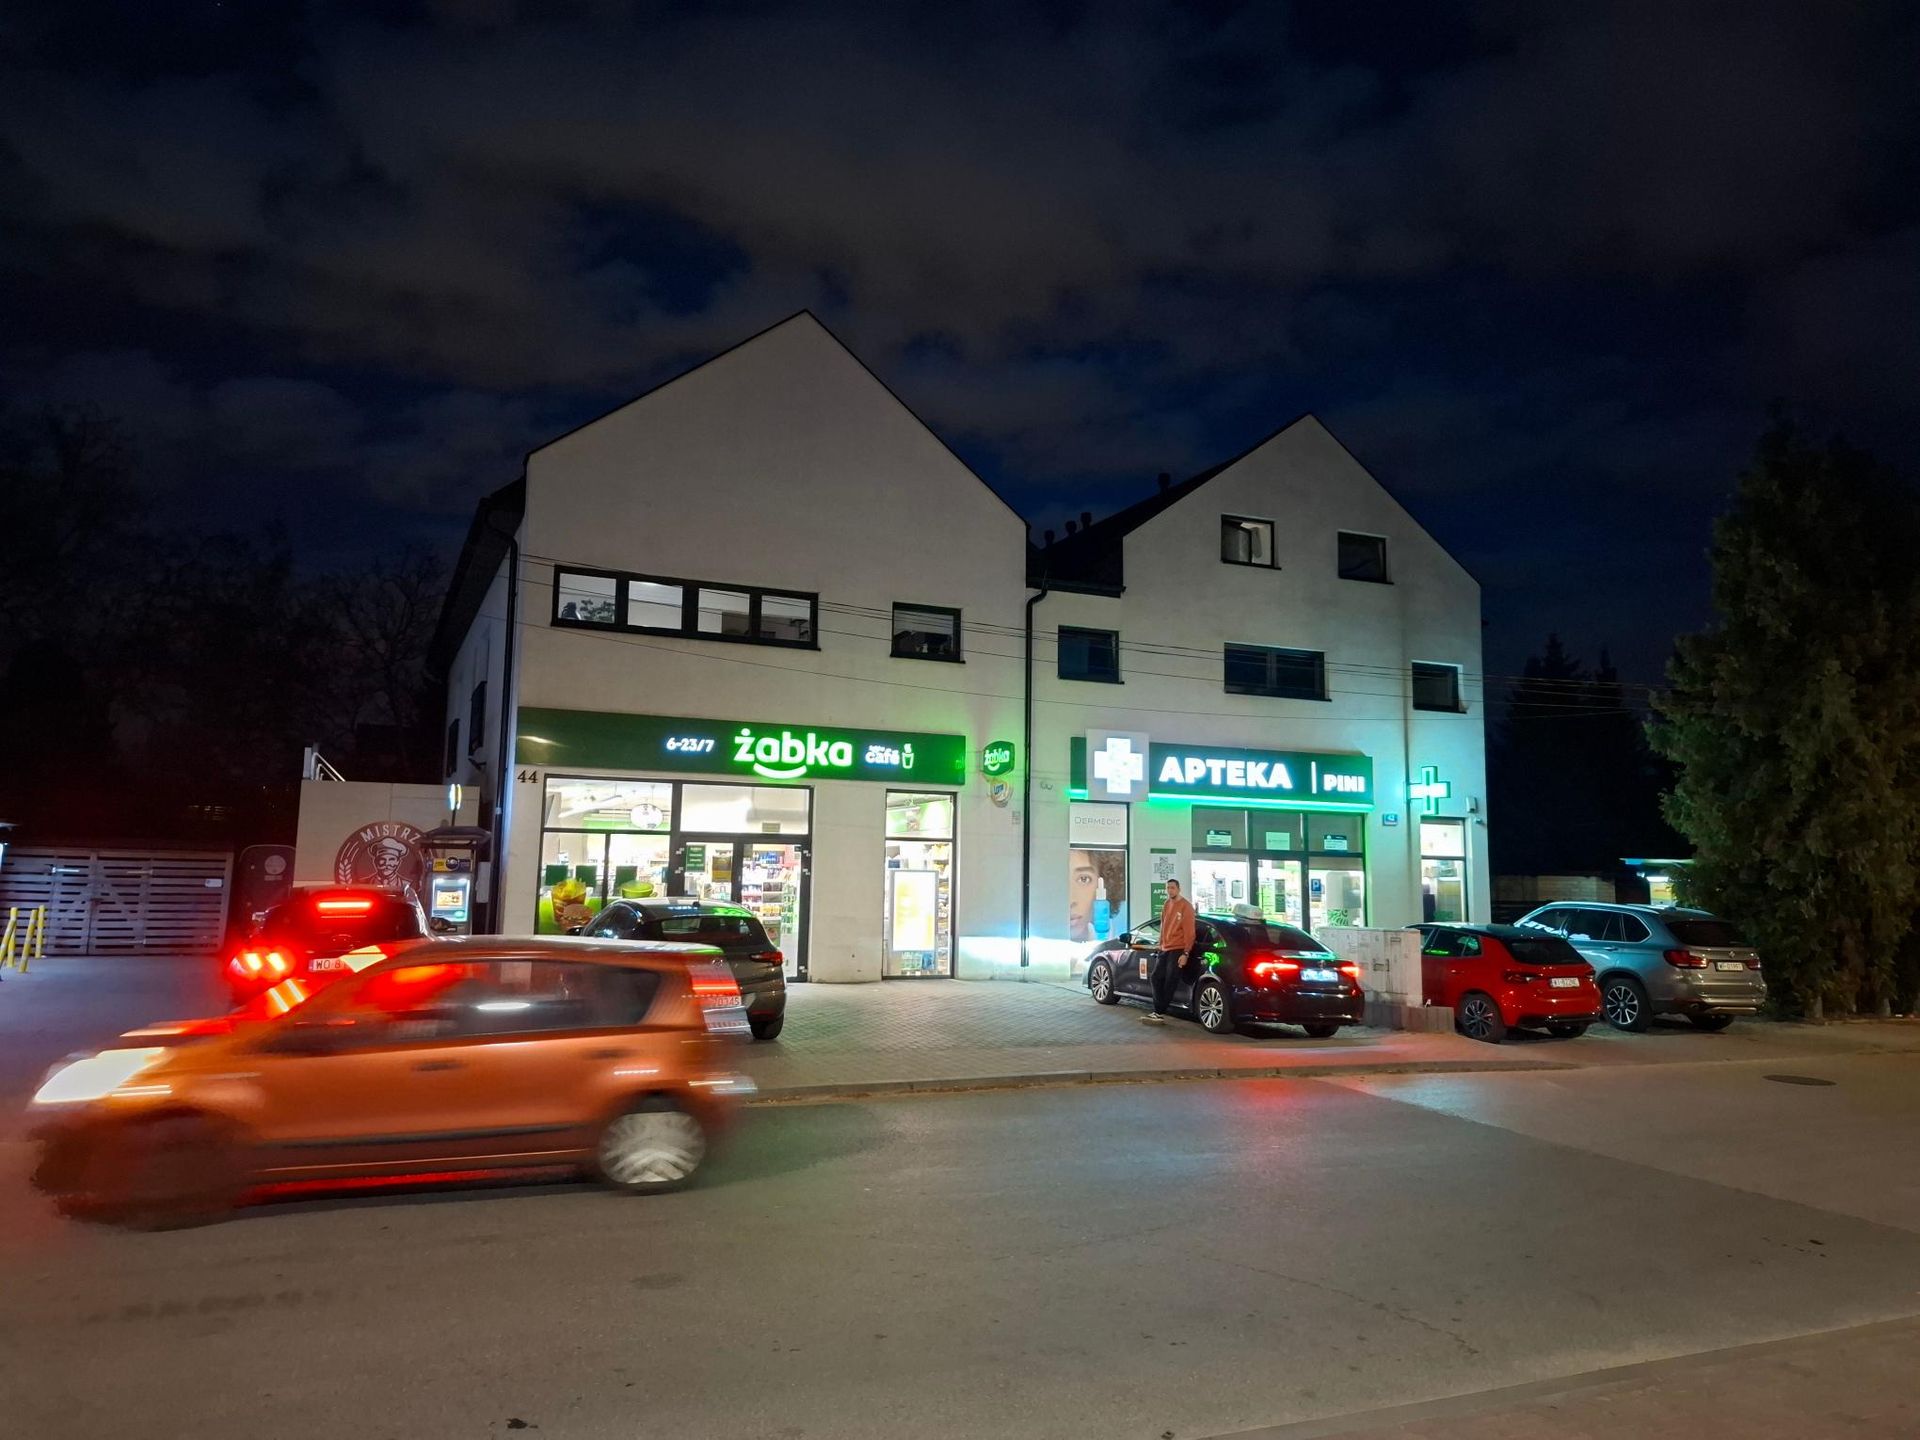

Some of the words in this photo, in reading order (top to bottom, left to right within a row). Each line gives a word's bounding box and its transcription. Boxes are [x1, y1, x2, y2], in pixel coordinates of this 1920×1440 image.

[666, 737, 714, 752] 6-23/7
[734, 728, 853, 767] żabka
[517, 769, 538, 783] 44
[1159, 756, 1293, 789] APTEKA
[1323, 774, 1366, 792] PINI
[360, 824, 420, 845] MISTRZ
